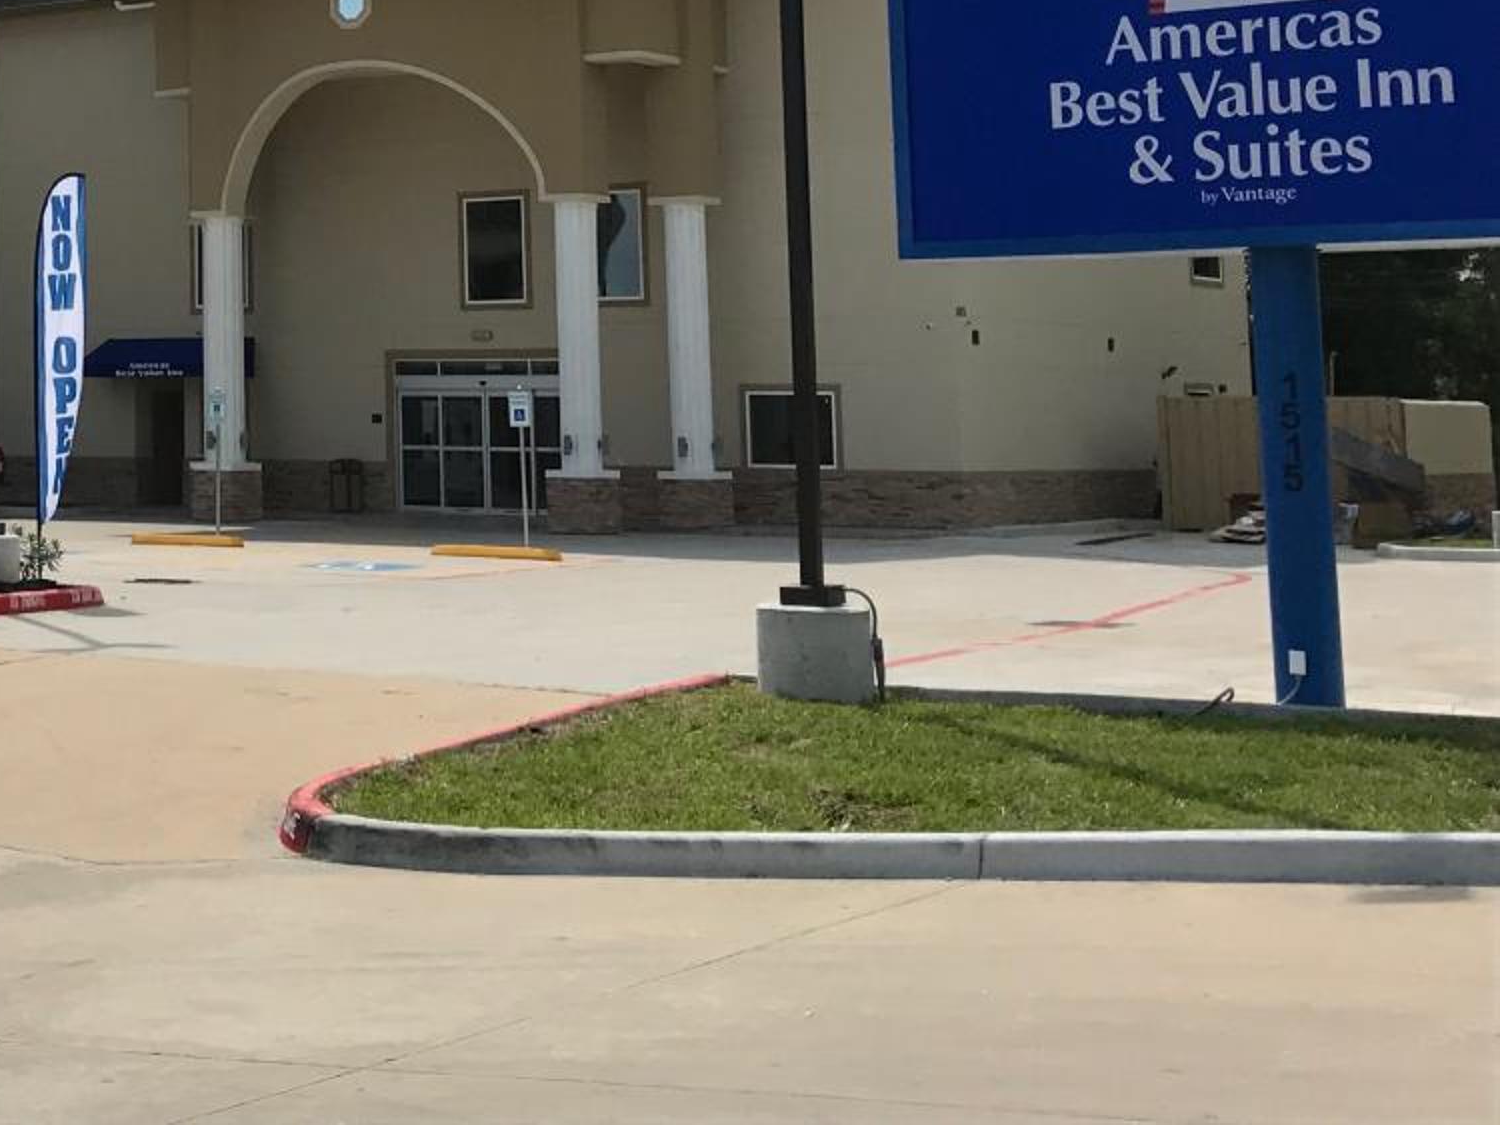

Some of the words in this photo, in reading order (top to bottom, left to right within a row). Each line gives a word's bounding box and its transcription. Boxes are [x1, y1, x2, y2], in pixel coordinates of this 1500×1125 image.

[1105, 6, 1383, 65] Americas
[1049, 76, 1166, 130] Best
[1177, 61, 1338, 120] Value
[1357, 58, 1456, 109] Inn
[1129, 134, 1174, 185] &
[1193, 122, 1372, 182] Suites
[1201, 190, 1219, 206] by
[1220, 186, 1297, 205] Vantage
[48, 195, 76, 311] NOW
